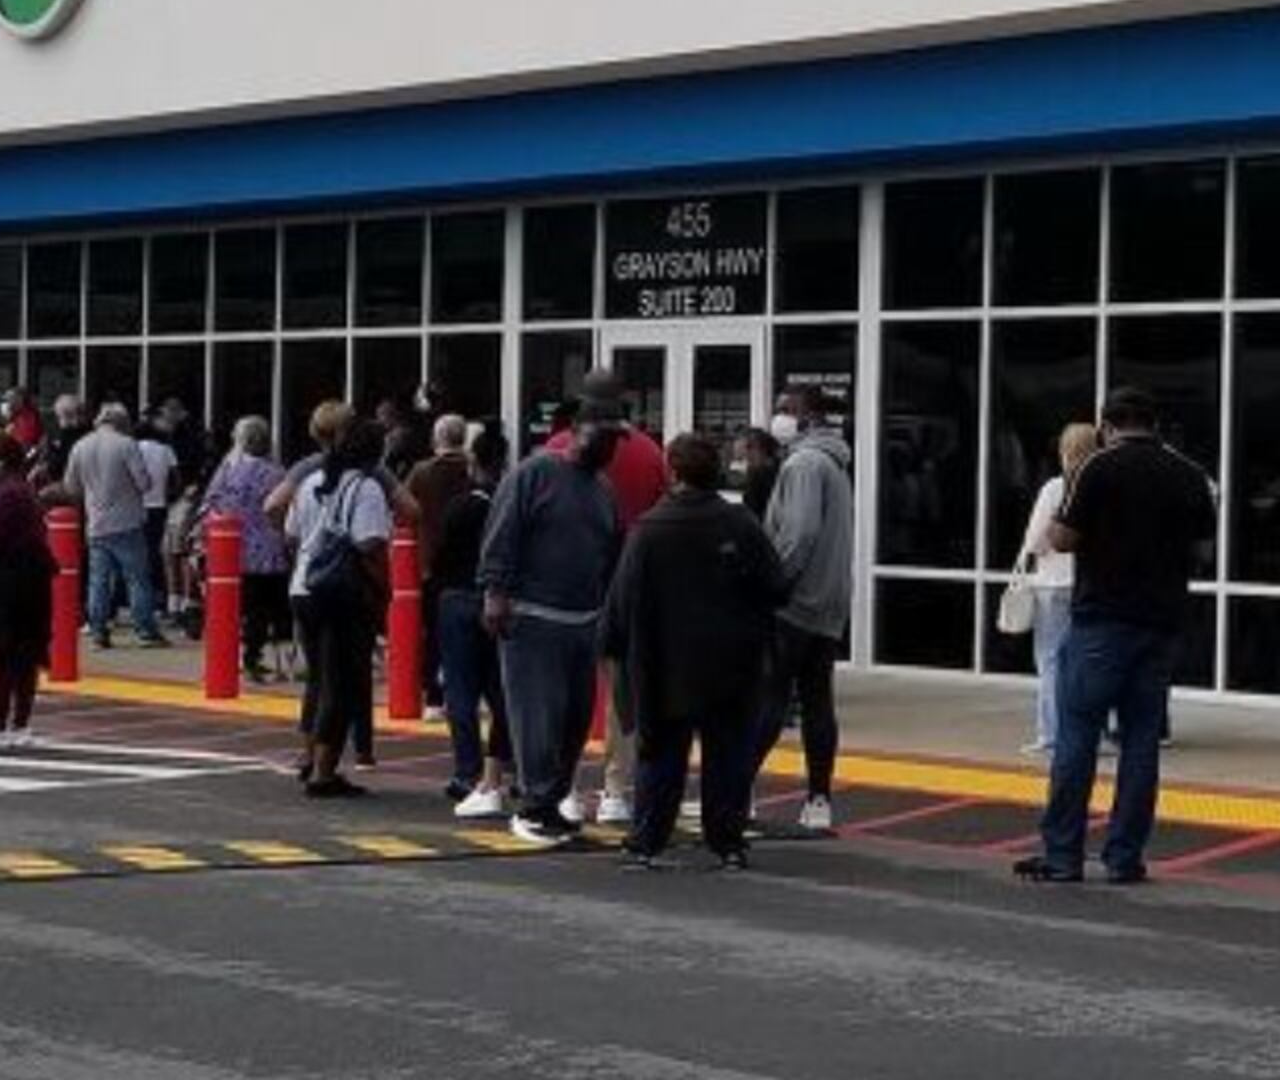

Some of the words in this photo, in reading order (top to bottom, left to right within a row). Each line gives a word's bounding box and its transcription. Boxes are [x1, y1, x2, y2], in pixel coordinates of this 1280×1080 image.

[666, 202, 712, 238] 455
[613, 251, 710, 280] GRAYSON
[716, 247, 765, 276] HWY
[637, 288, 696, 318] SUITE
[699, 284, 736, 313] 200
